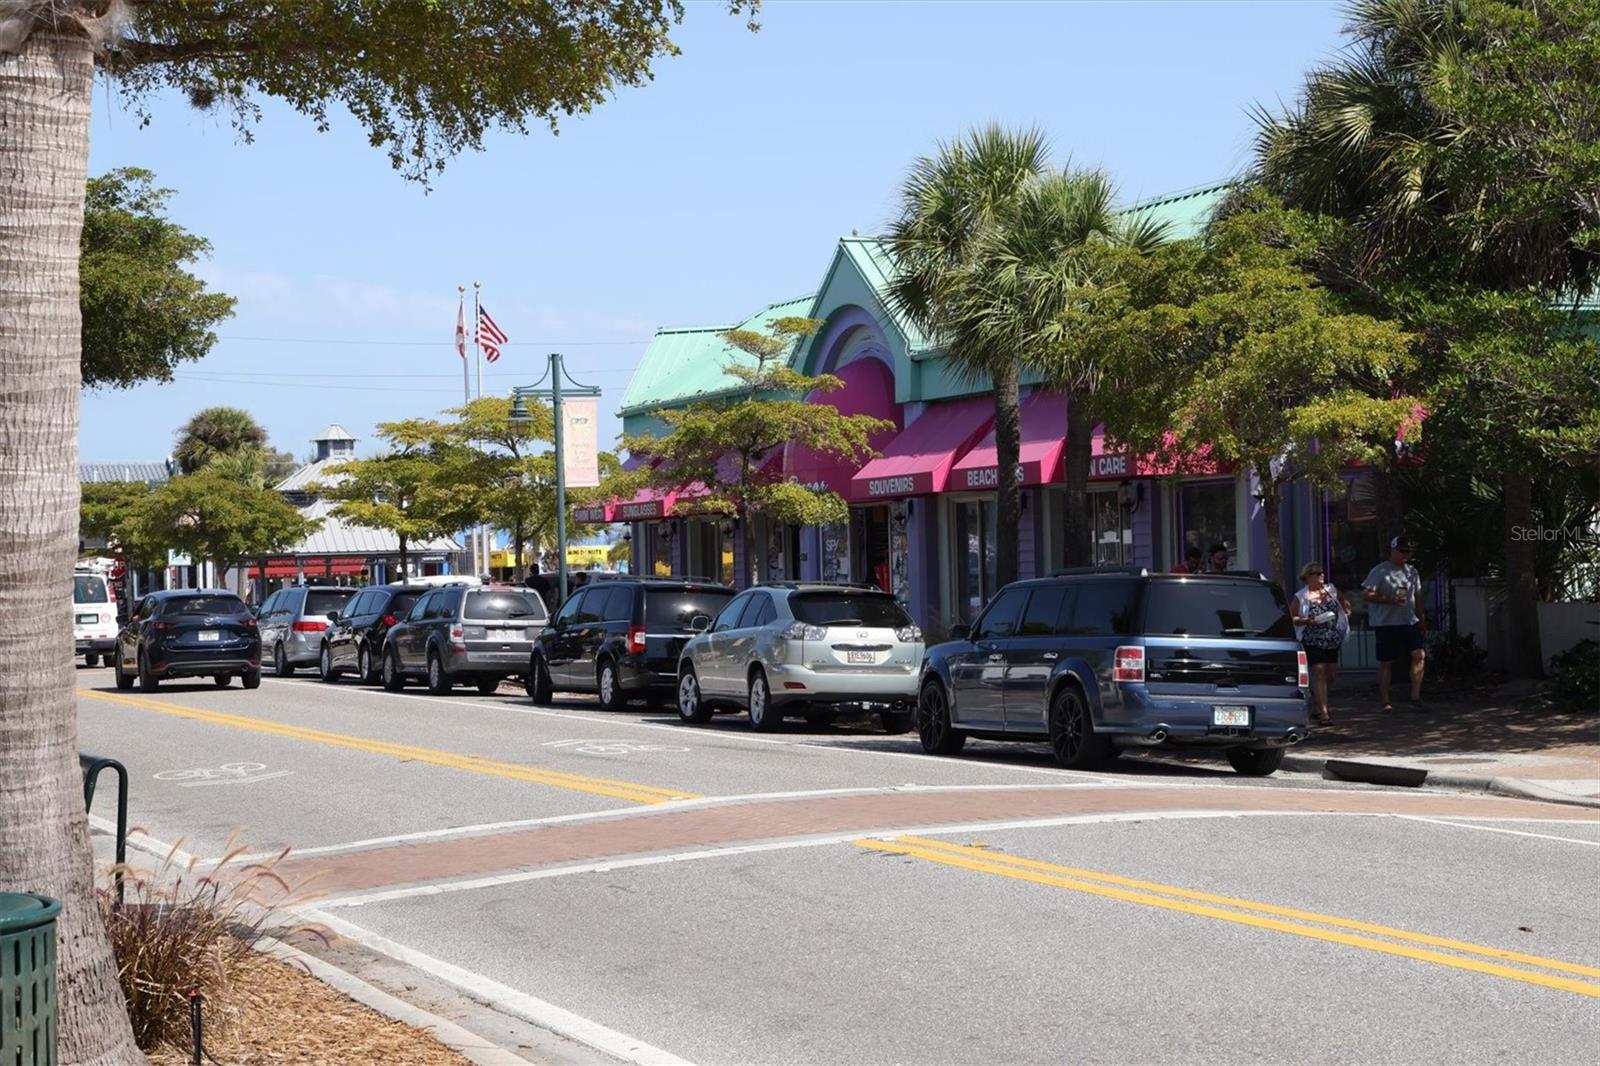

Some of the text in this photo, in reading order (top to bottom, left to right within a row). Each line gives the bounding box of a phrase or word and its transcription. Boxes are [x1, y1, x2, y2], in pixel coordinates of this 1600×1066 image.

[1099, 456, 1126, 475] CARE
[869, 477, 914, 496] SOUVENIRS
[968, 469, 998, 486] BEACH
[623, 503, 657, 518] SUNGLASSES
